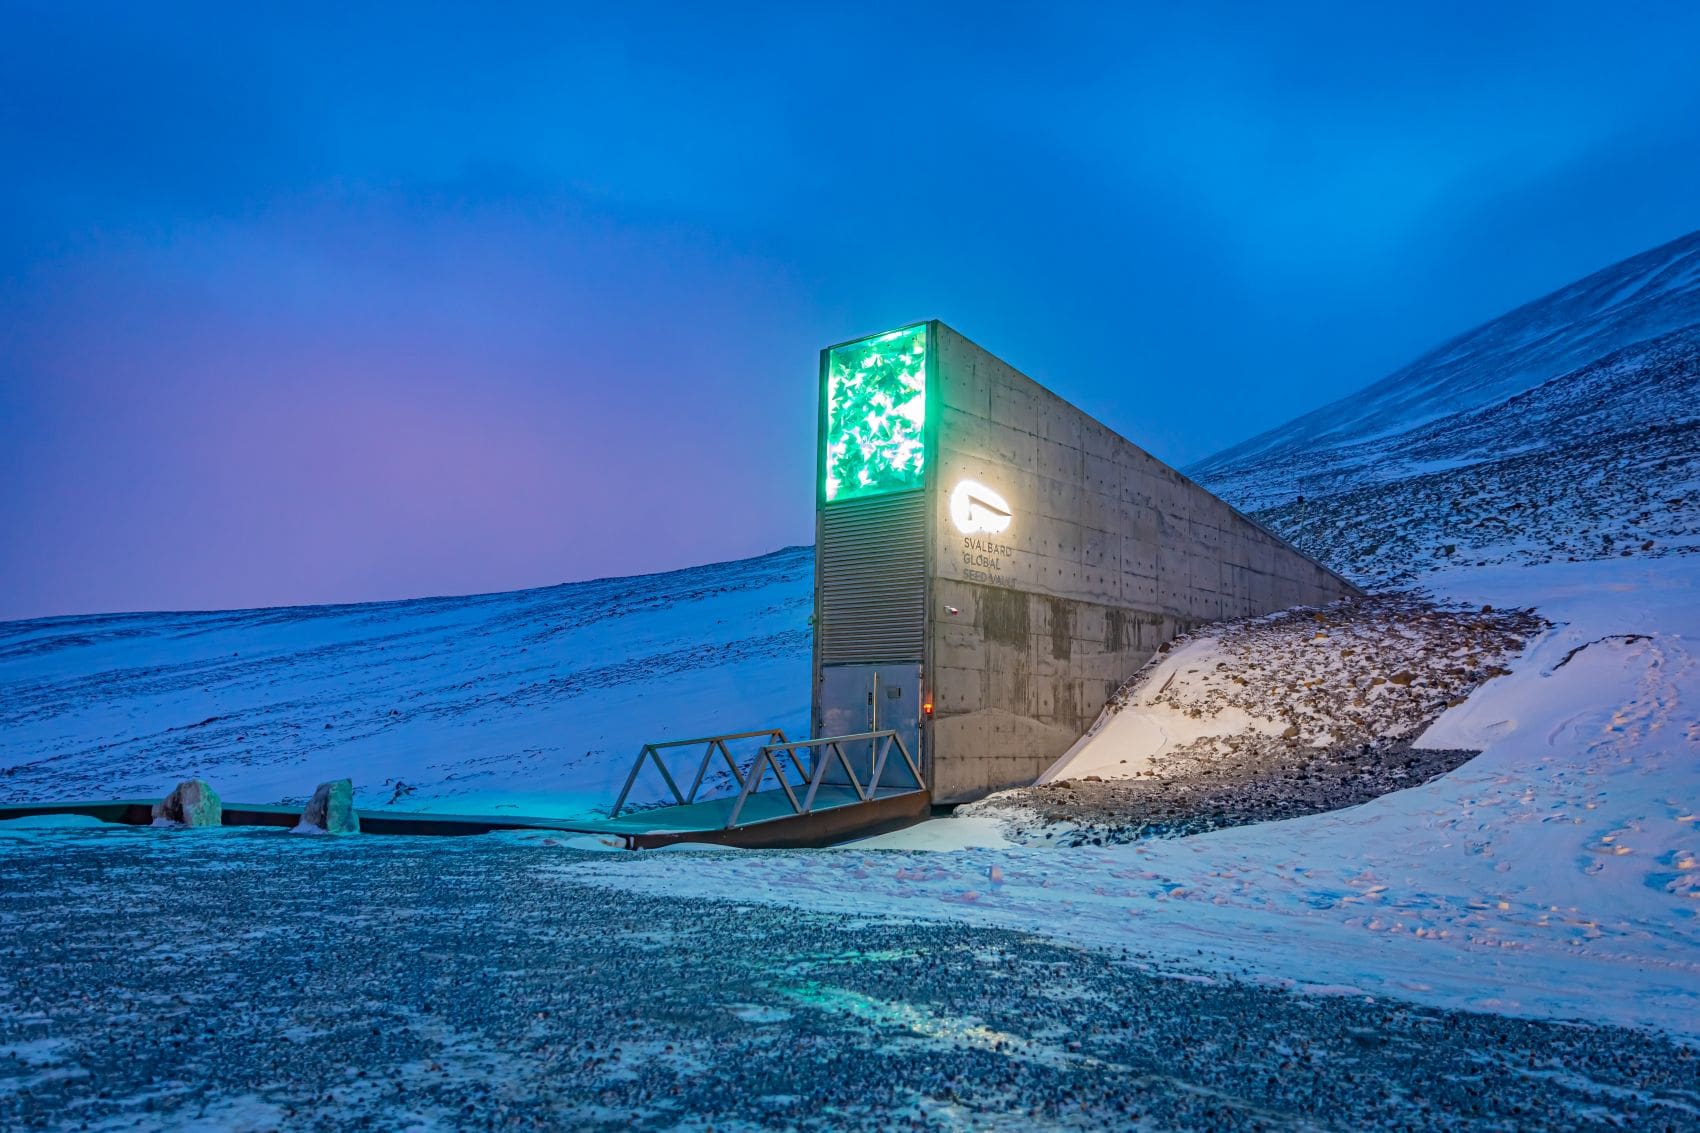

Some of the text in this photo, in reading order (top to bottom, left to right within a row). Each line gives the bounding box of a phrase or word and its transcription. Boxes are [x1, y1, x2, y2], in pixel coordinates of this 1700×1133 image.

[964, 537, 1012, 557] SVALBARD
[963, 553, 1001, 570] GLOBAL
[963, 569, 987, 583] SEED
